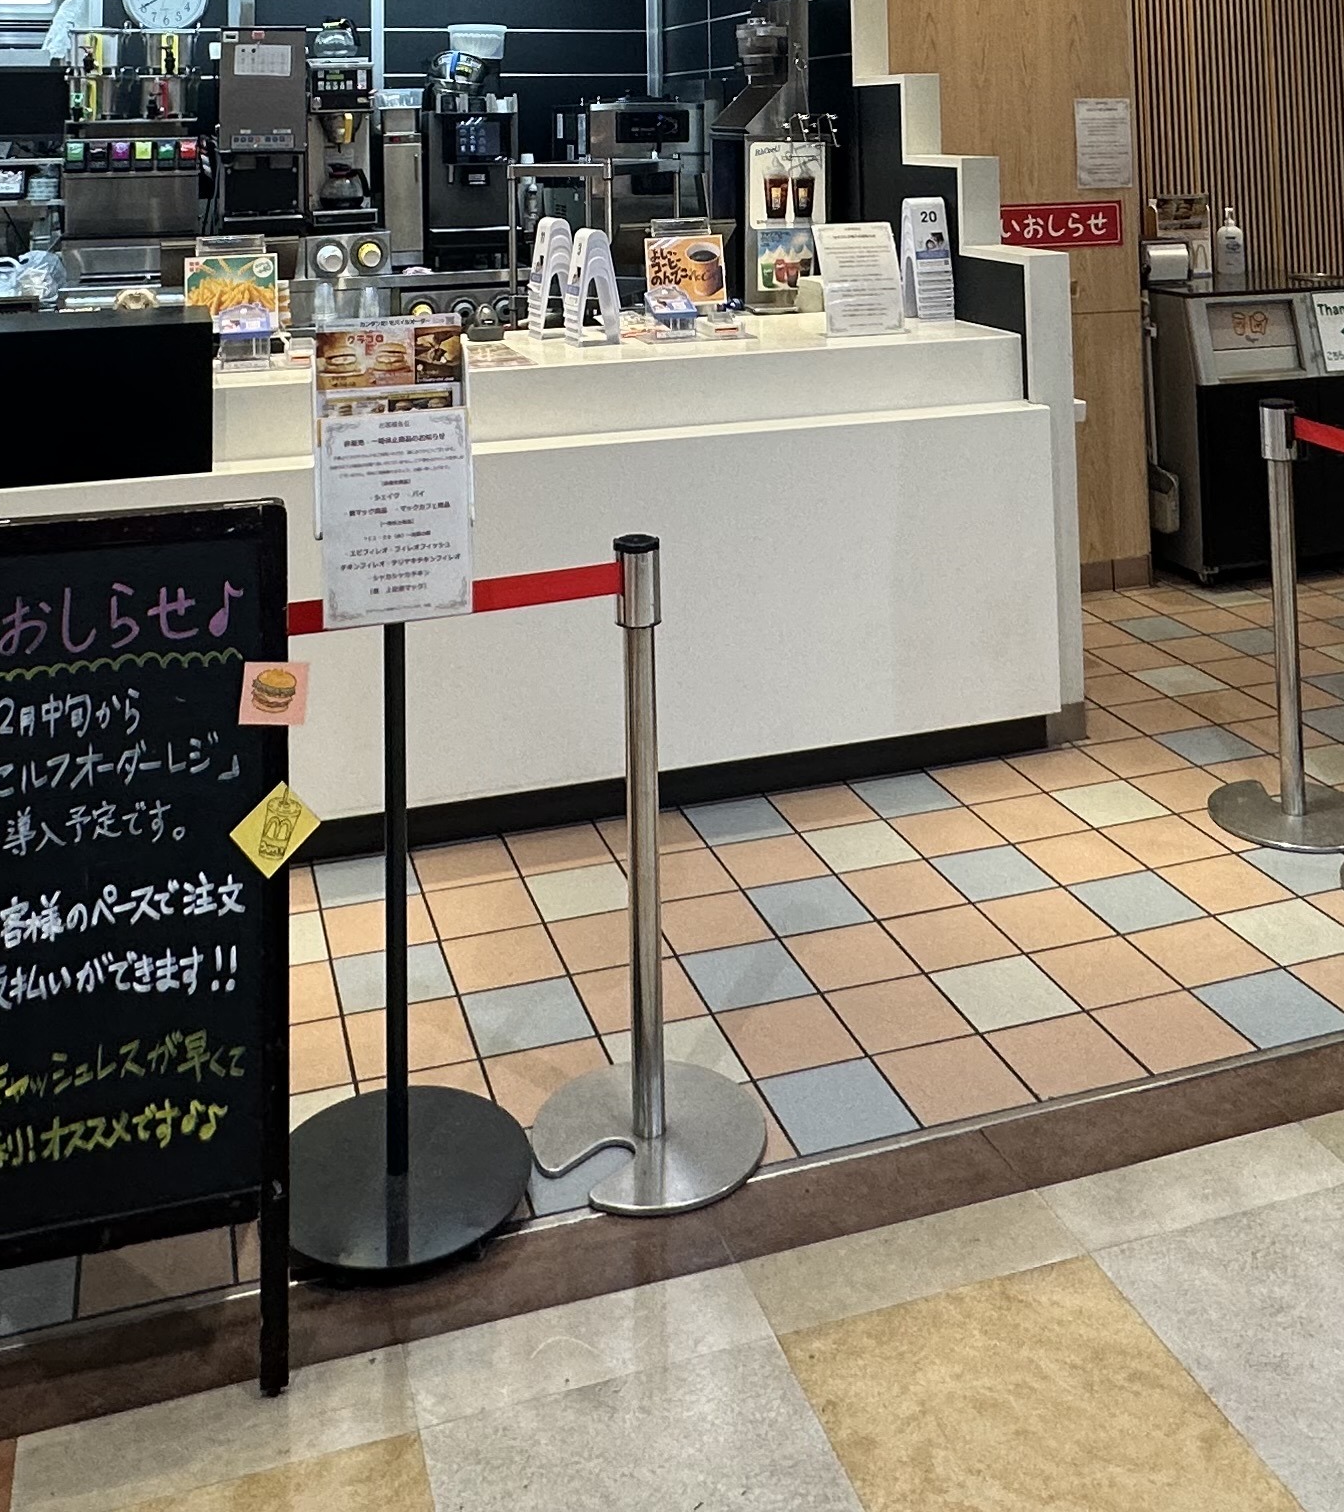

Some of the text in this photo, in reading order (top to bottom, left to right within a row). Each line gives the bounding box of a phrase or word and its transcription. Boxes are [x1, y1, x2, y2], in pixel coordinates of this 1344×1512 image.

[920, 210, 938, 223] 20
[1001, 211, 1108, 239] いおしらせ
